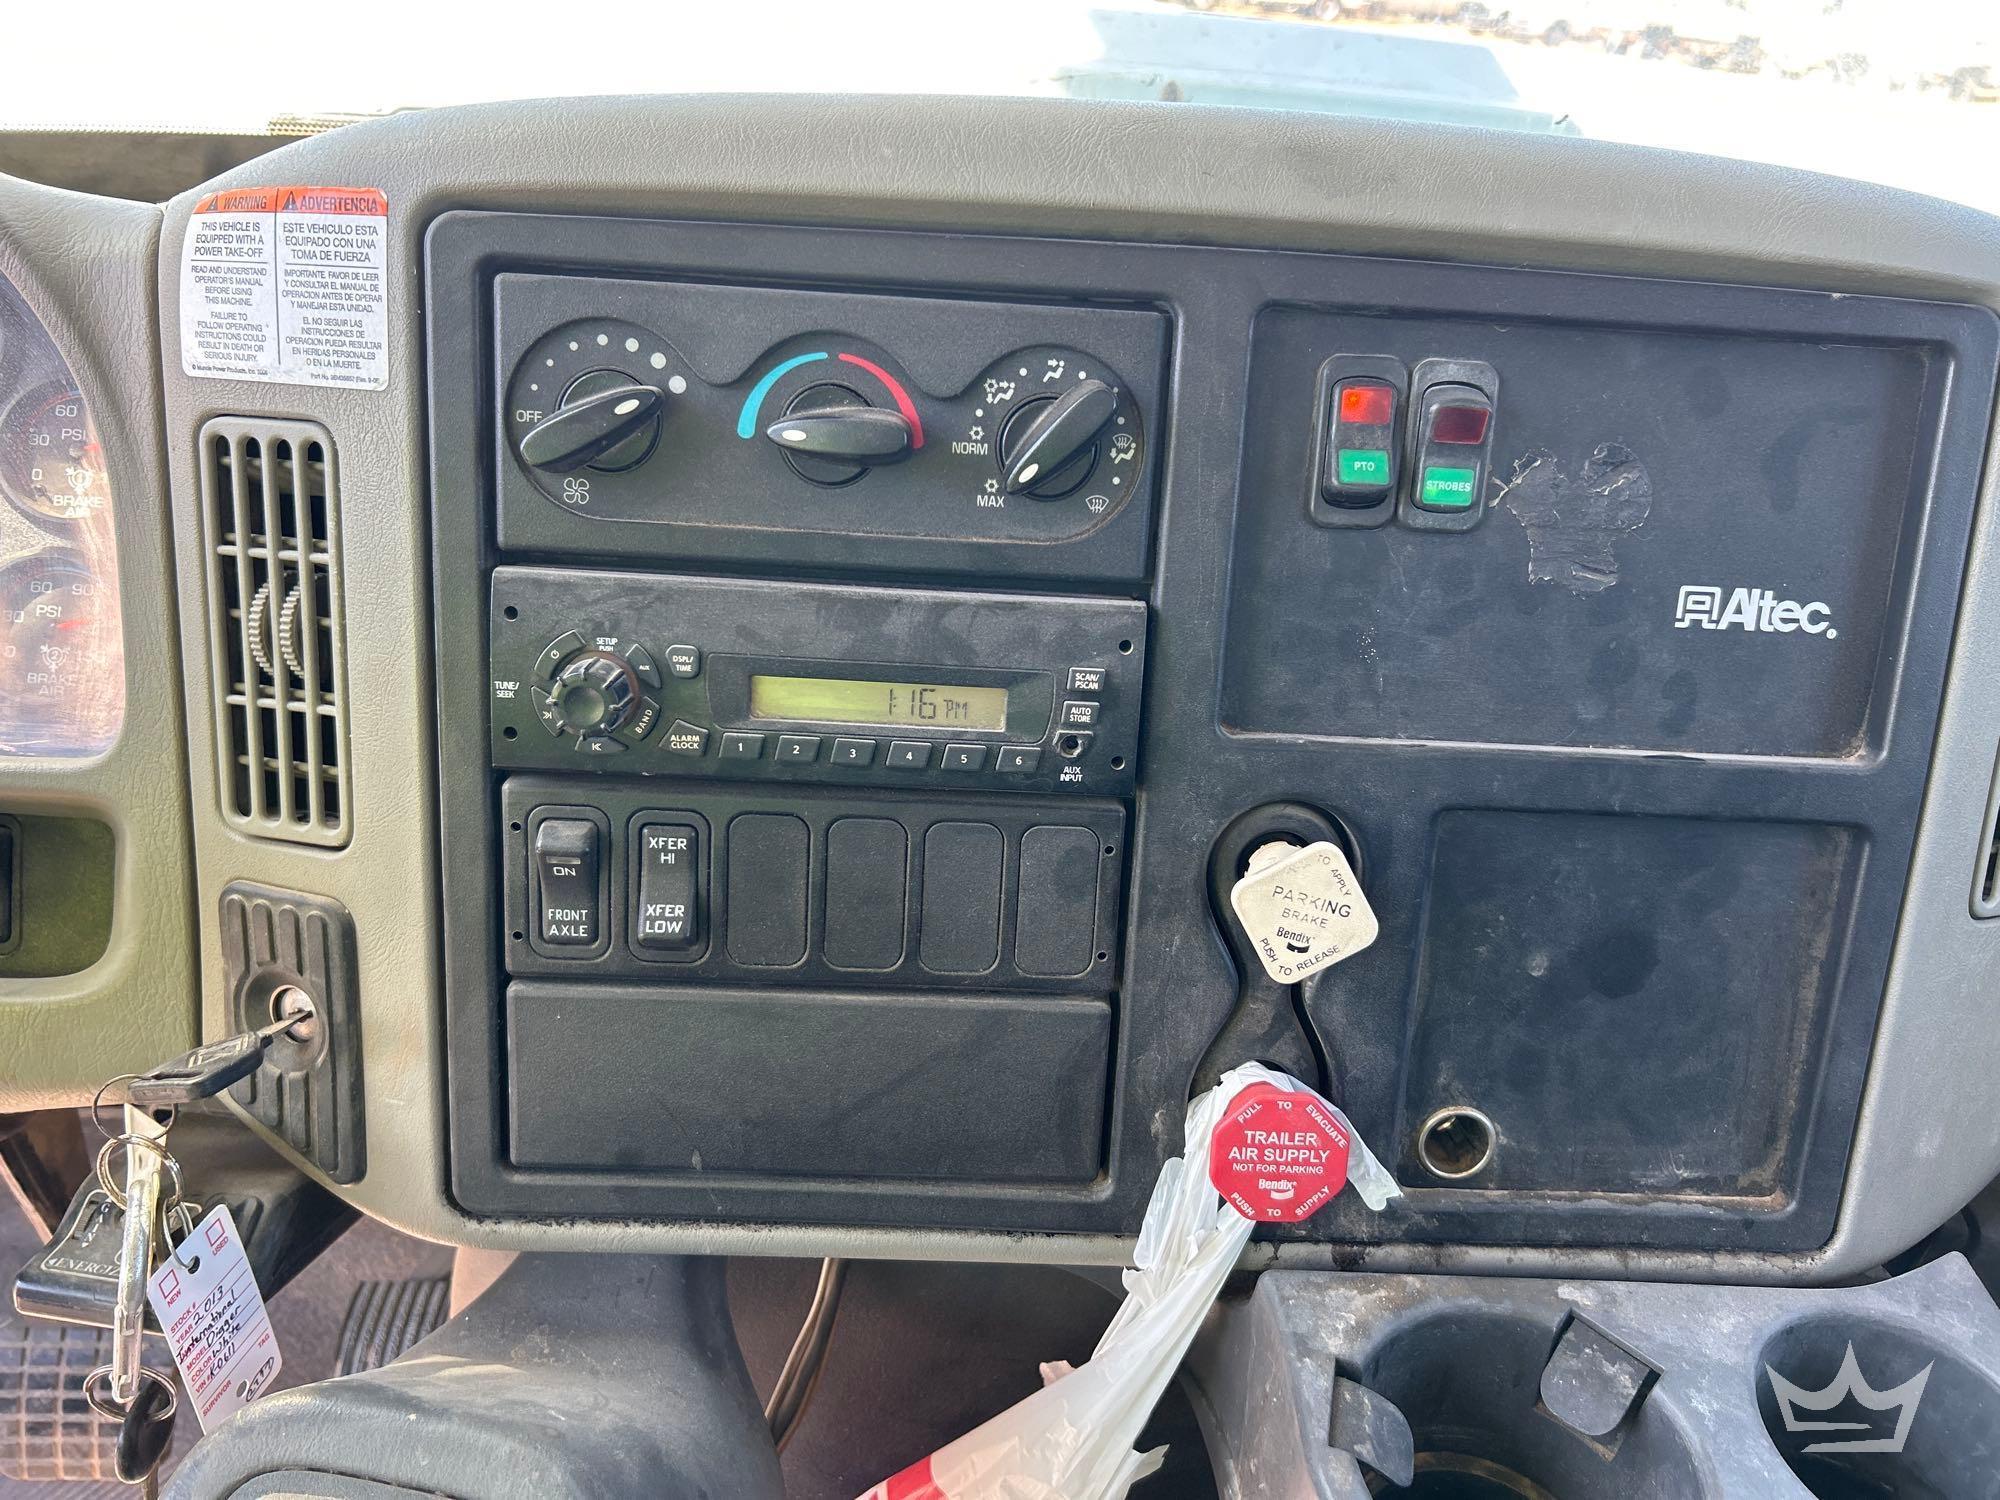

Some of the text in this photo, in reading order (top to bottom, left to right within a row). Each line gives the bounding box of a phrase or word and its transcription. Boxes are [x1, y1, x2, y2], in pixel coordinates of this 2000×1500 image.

[224, 196, 267, 209] WARNING
[300, 196, 378, 212] ADVERTENCIA
[202, 222, 260, 232] THIS VEHICLE IS
[283, 223, 379, 236] ESTE VEHICULO ESTA
[196, 234, 264, 245] EQUIPPED WITH A
[286, 236, 376, 249] EQUIPADO CON UNA
[195, 247, 263, 258] POWER TAKE-OFF
[291, 250, 371, 263] TOMA DE FUERZA
[209, 266, 223, 274] AND
[224, 267, 267, 276] UNDERSTAND
[328, 271, 379, 281] FAVOR DE LEER
[195, 276, 263, 286] OPERATOR'S MANUAL
[291, 280, 329, 289] CONSULTAR
[331, 282, 339, 290] EL
[340, 283, 368, 291] MANUAL
[370, 284, 379, 292] DE
[205, 286, 253, 296] BEFORE USING
[282, 290, 383, 302] OPERACION ANTES DE OPERAR
[205, 296, 219, 304] THIS
[297, 301, 328, 311] MANEJAR
[329, 303, 346, 311] ESTA
[347, 304, 374, 313] UNIDAD.
[211, 312, 248, 321] FAILURE TO
[303, 317, 311, 325] EL
[324, 318, 349, 327] SEGUIR
[350, 320, 363, 328] LAS
[198, 321, 263, 332] FOLLOW OPERATING
[302, 327, 354, 337] INSTRUCCIONES
[195, 331, 266, 342] INSTRUCTIONS COULD
[198, 341, 222, 349] RESULT
[231, 343, 252, 352] DEATH
[286, 336, 382, 350] OPERACION RESULTAR
[205, 351, 232, 361] SERIOUS
[292, 347, 376, 360] EN HERIDAS PERSONALES
[56, 405, 77, 417] 60
[516, 410, 543, 422] OFF
[29, 434, 49, 446] 30
[62, 429, 86, 440] PSI
[952, 442, 988, 455] NORM
[1355, 462, 1375, 472] PTO
[32, 469, 42, 480] 0
[1427, 481, 1472, 492] STROBES
[53, 495, 104, 507] BRAKE
[977, 495, 1005, 508] MAX
[64, 507, 91, 518] AIR
[31, 581, 93, 596] 60 90
[36, 605, 62, 618] PSI
[596, 637, 618, 646] SETUP
[673, 656, 694, 664] DSPL/
[676, 664, 692, 672] TIME
[27, 673, 77, 684] BRAKE
[1076, 672, 1099, 681] SCAN/
[495, 681, 519, 690] TUNE/
[1075, 680, 1099, 690] PSCAN
[39, 686, 64, 697] AIR
[497, 690, 515, 699] SEEK
[889, 688, 968, 720] 1:16 PM
[1070, 707, 1091, 716] AUTO
[635, 709, 653, 734] BAND
[1070, 715, 1091, 723] STORE
[670, 734, 700, 743] ALARM
[671, 741, 699, 750] CLOCK
[738, 743, 1022, 766] 1 2 3 4 5 6
[1063, 766, 1081, 774] AUX
[1060, 773, 1083, 782] INPUT
[649, 837, 687, 850] XFER
[661, 853, 675, 864] HI
[553, 867, 576, 876] ON
[1318, 854, 1351, 897] TO APPLY
[1272, 886, 1351, 918] PARKING
[549, 909, 588, 921] FRONT
[646, 904, 685, 917] XFER
[1282, 908, 1329, 928] BRAKE
[549, 925, 588, 936] AXLE
[646, 921, 682, 933] LOW
[1276, 927, 1311, 944] Bendix
[1260, 938, 1341, 976] PUSH TO RELEASE
[1237, 1101, 1347, 1148] PULL TO EVACUATE
[1245, 1131, 1318, 1147] TRAILER
[1229, 1147, 1331, 1163] AIR SUPPLY
[1256, 1164, 1277, 1173] FOR
[1280, 1165, 1323, 1174] PARKING
[1259, 1179, 1294, 1190] Bendix
[1231, 1185, 1330, 1217] PUSH TO SUPPLY
[212, 1236, 229, 1256] USED
[167, 1288, 183, 1308] NEW
[194, 1286, 223, 1325] 2013
[171, 1307, 192, 1334] STOCK
[206, 1305, 240, 1347] Digger
[176, 1324, 193, 1344] YEAR
[187, 1346, 207, 1371] MODEL
[192, 1357, 212, 1382] COLOR
[203, 1334, 270, 1416] SURVIVOR TAG
[196, 1381, 206, 1393] VIN
